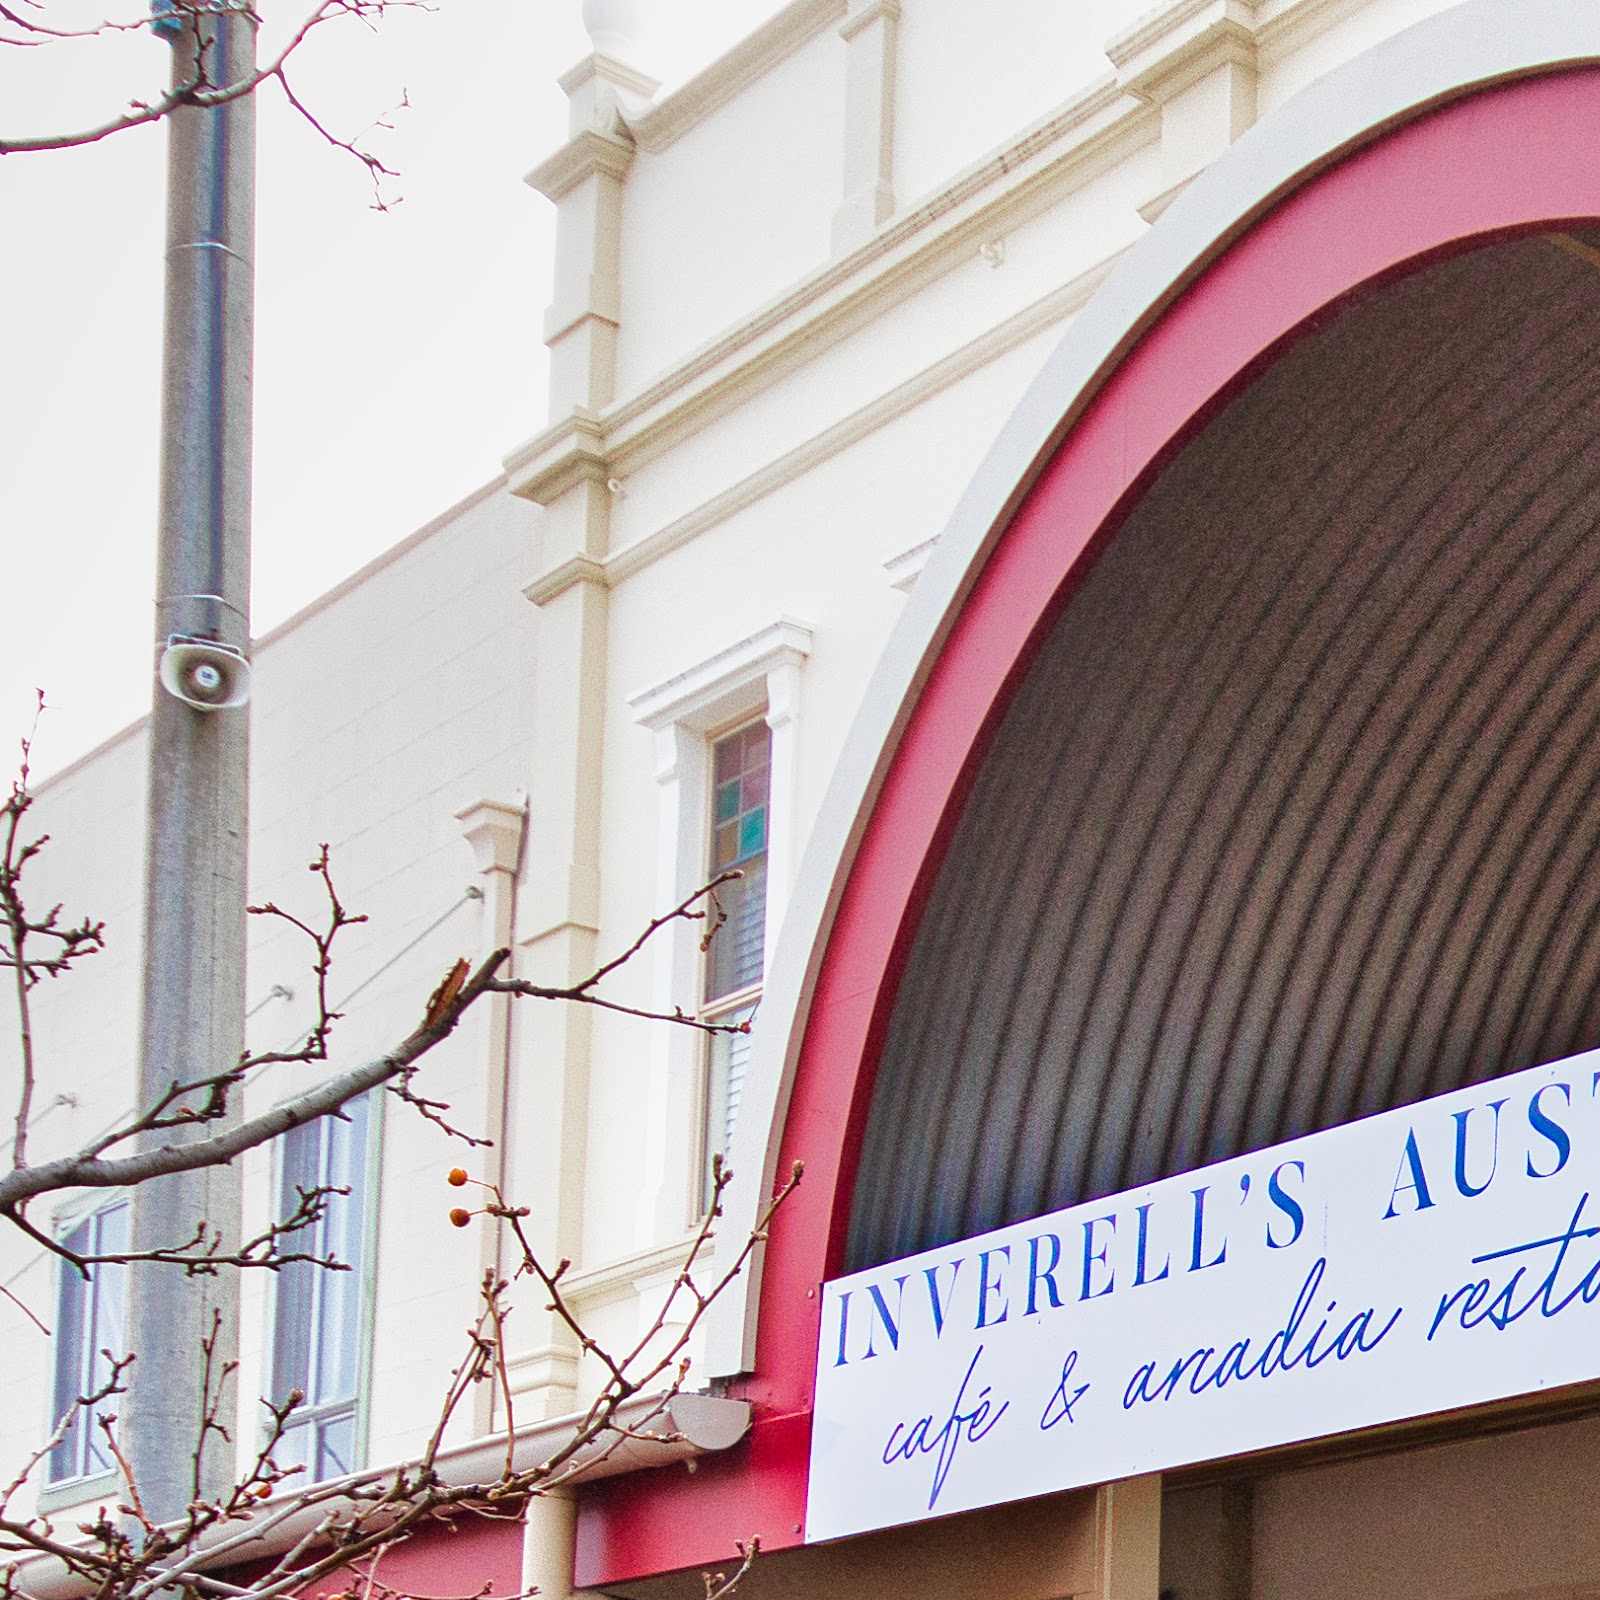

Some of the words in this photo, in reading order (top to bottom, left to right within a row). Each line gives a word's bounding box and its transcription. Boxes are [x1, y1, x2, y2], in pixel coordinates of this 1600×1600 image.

[833, 1158, 1306, 1367] INVERELL'S
[883, 1345, 1009, 1510] café
[1040, 1351, 1090, 1430] &
[1123, 1257, 1401, 1409] arcadia
